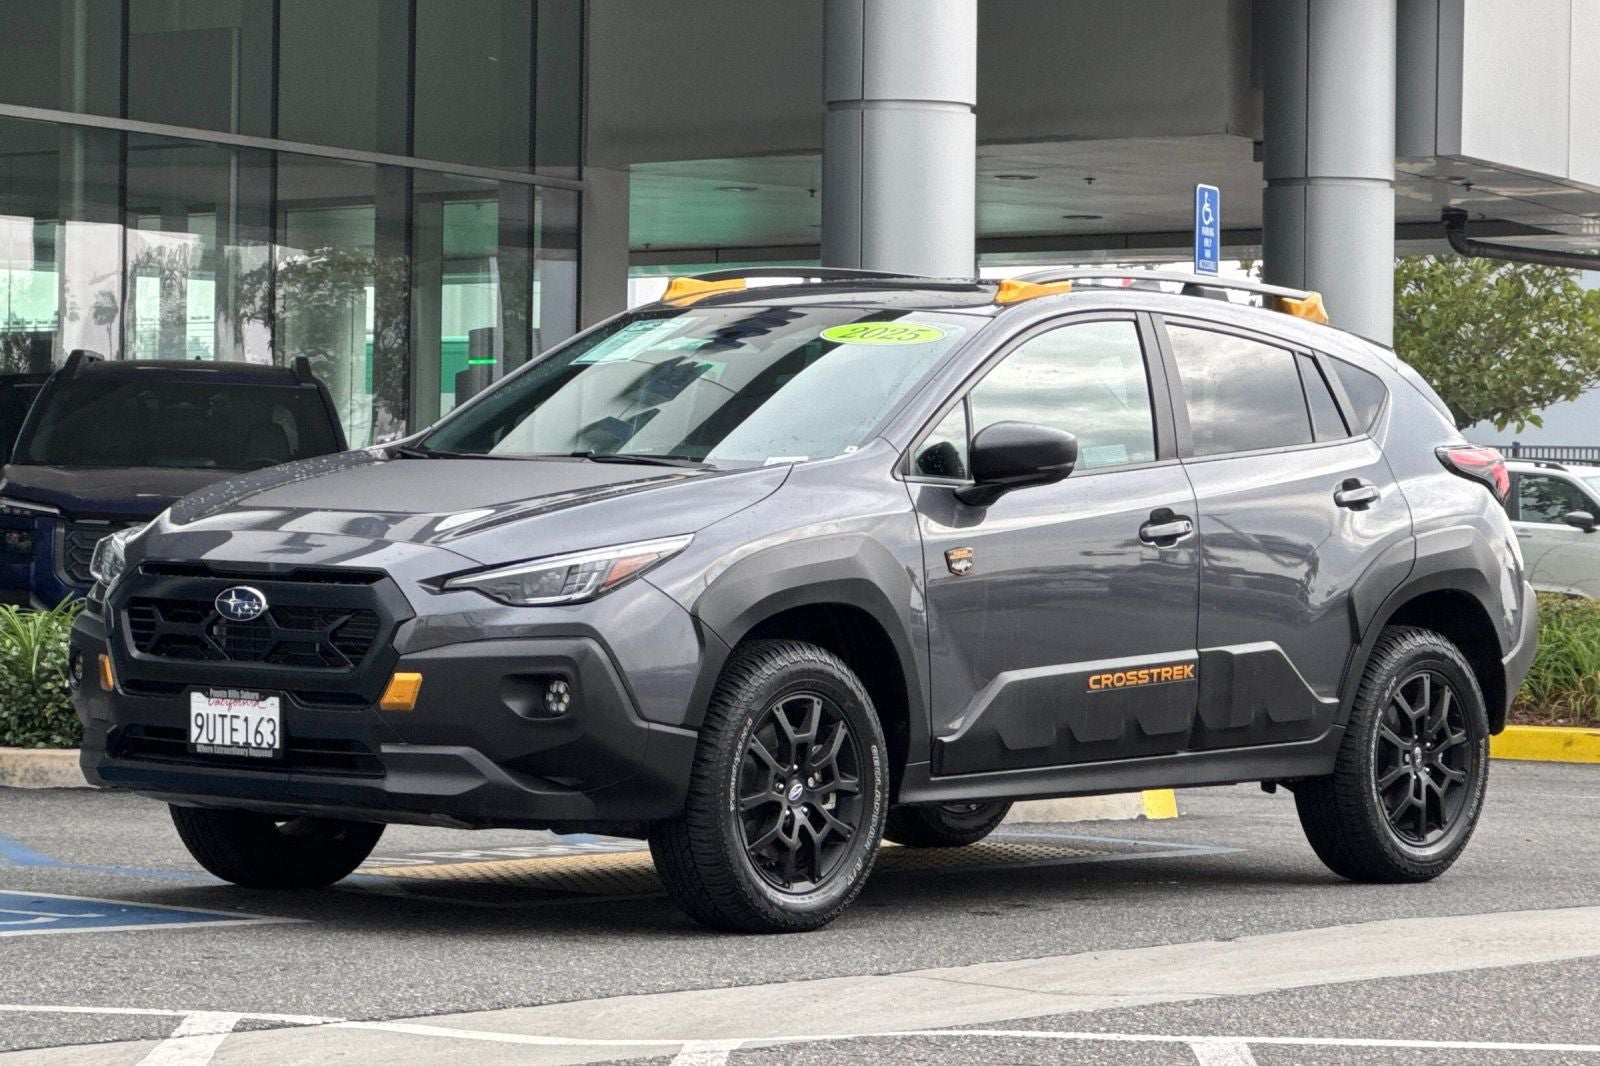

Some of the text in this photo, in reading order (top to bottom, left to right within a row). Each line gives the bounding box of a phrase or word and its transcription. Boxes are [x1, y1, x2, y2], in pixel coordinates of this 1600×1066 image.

[838, 327, 929, 341] 2025
[1088, 664, 1195, 690] CROSSTREK
[194, 712, 276, 749] 9UTE163
[865, 745, 882, 850] GEOLANDAR
